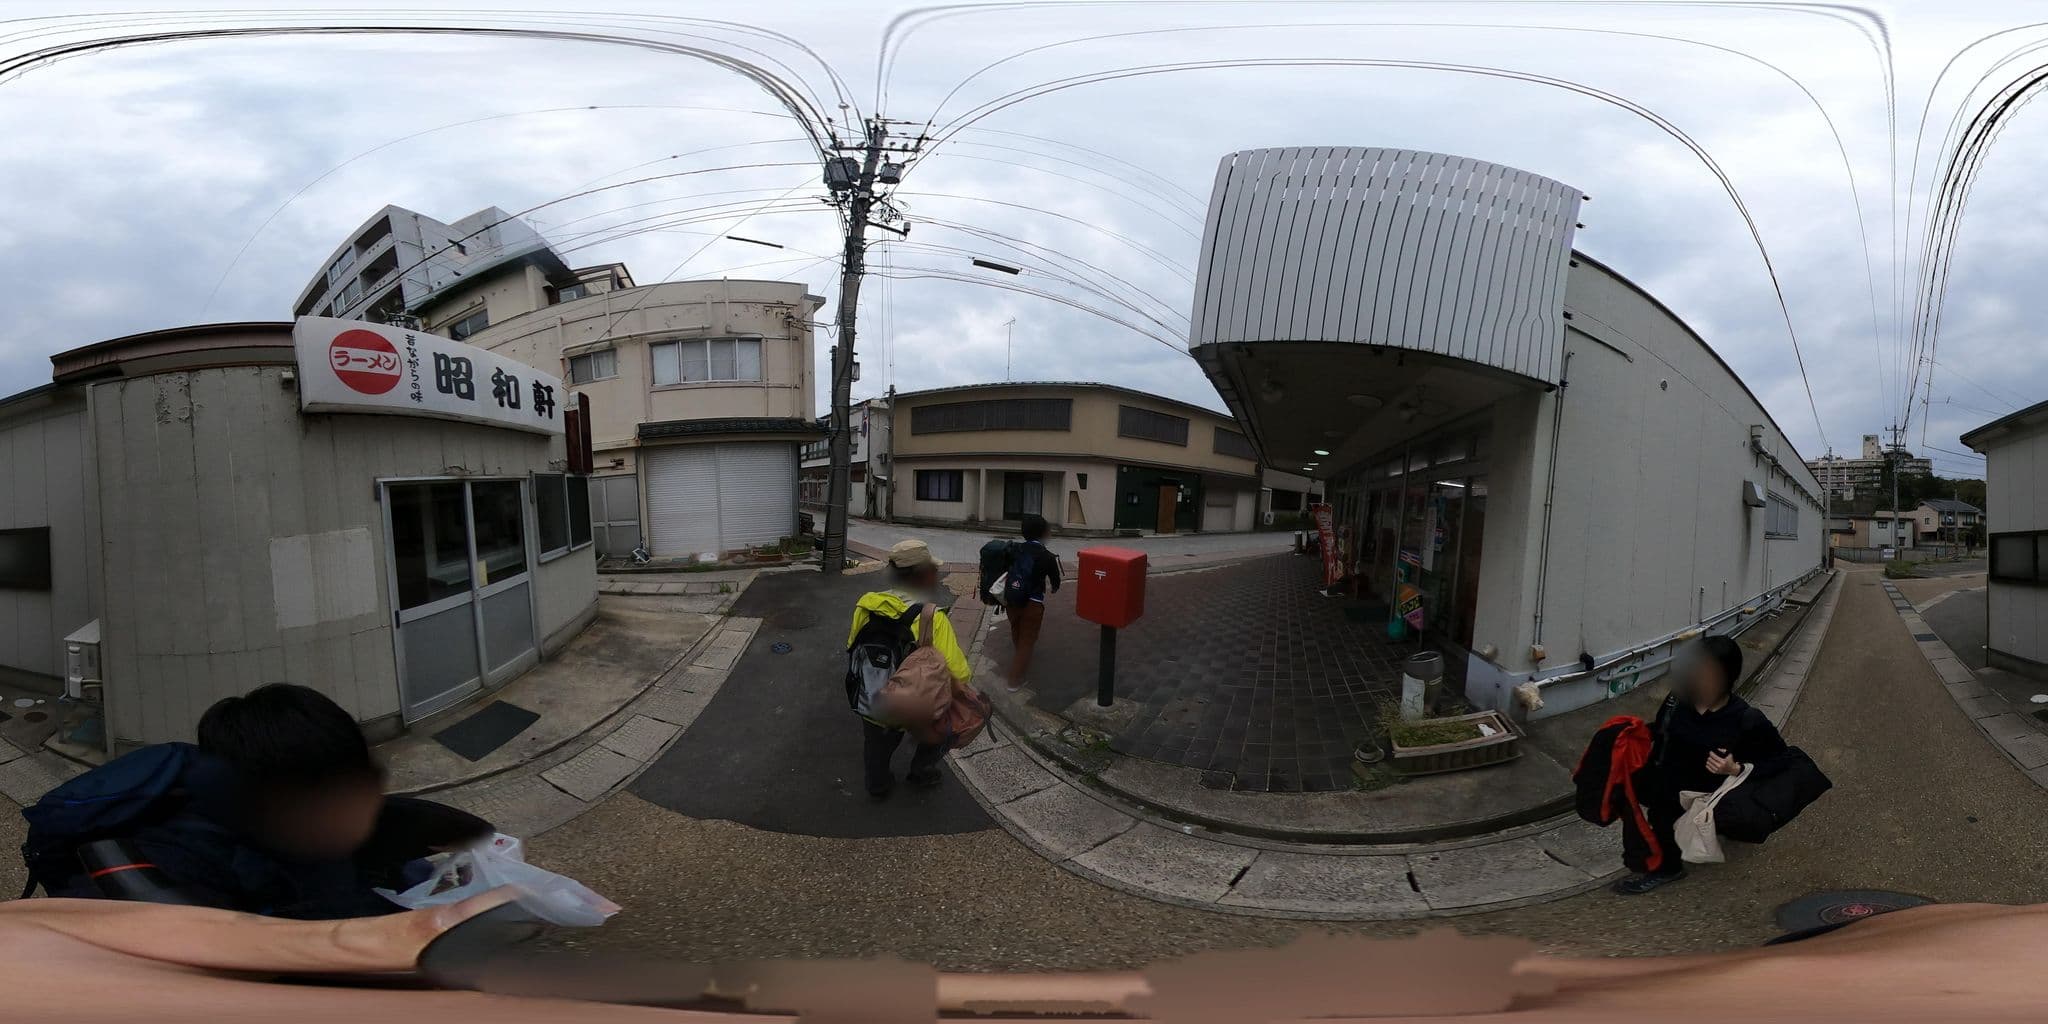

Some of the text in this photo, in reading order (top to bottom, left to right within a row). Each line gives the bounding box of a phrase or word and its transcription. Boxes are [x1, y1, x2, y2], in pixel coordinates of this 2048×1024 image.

[333, 350, 397, 371] ラーメン
[405, 334, 423, 403] 昔ながらの味
[433, 352, 555, 419] 昭和軒
